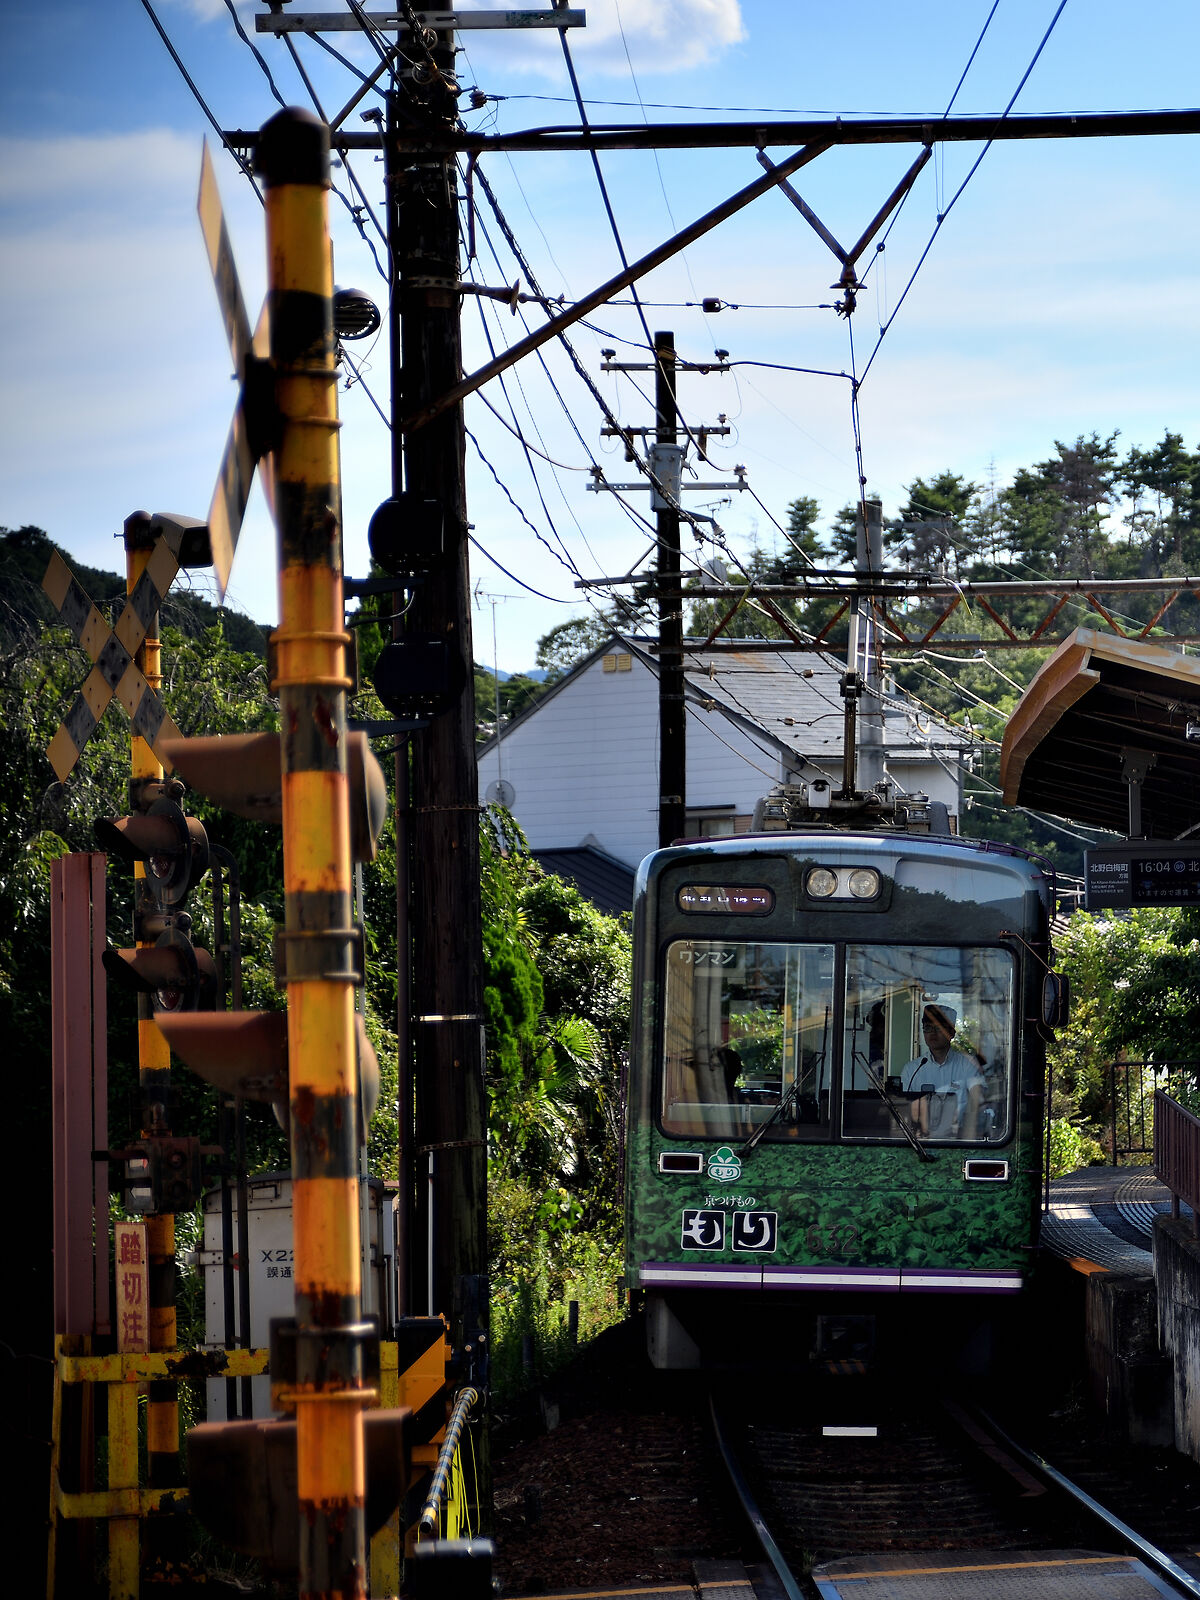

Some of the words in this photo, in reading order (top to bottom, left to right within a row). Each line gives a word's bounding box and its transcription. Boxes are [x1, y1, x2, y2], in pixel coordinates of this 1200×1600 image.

[1138, 861, 1170, 873] 16:04
[679, 950, 735, 964] ワンマン
[703, 1194, 756, 1207] 京つけもの
[682, 1210, 771, 1249] もり
[807, 1223, 860, 1254] 632
[261, 1250, 293, 1262] X2
[266, 1266, 293, 1278] 誤通
[121, 1230, 145, 1347] 踏切注
